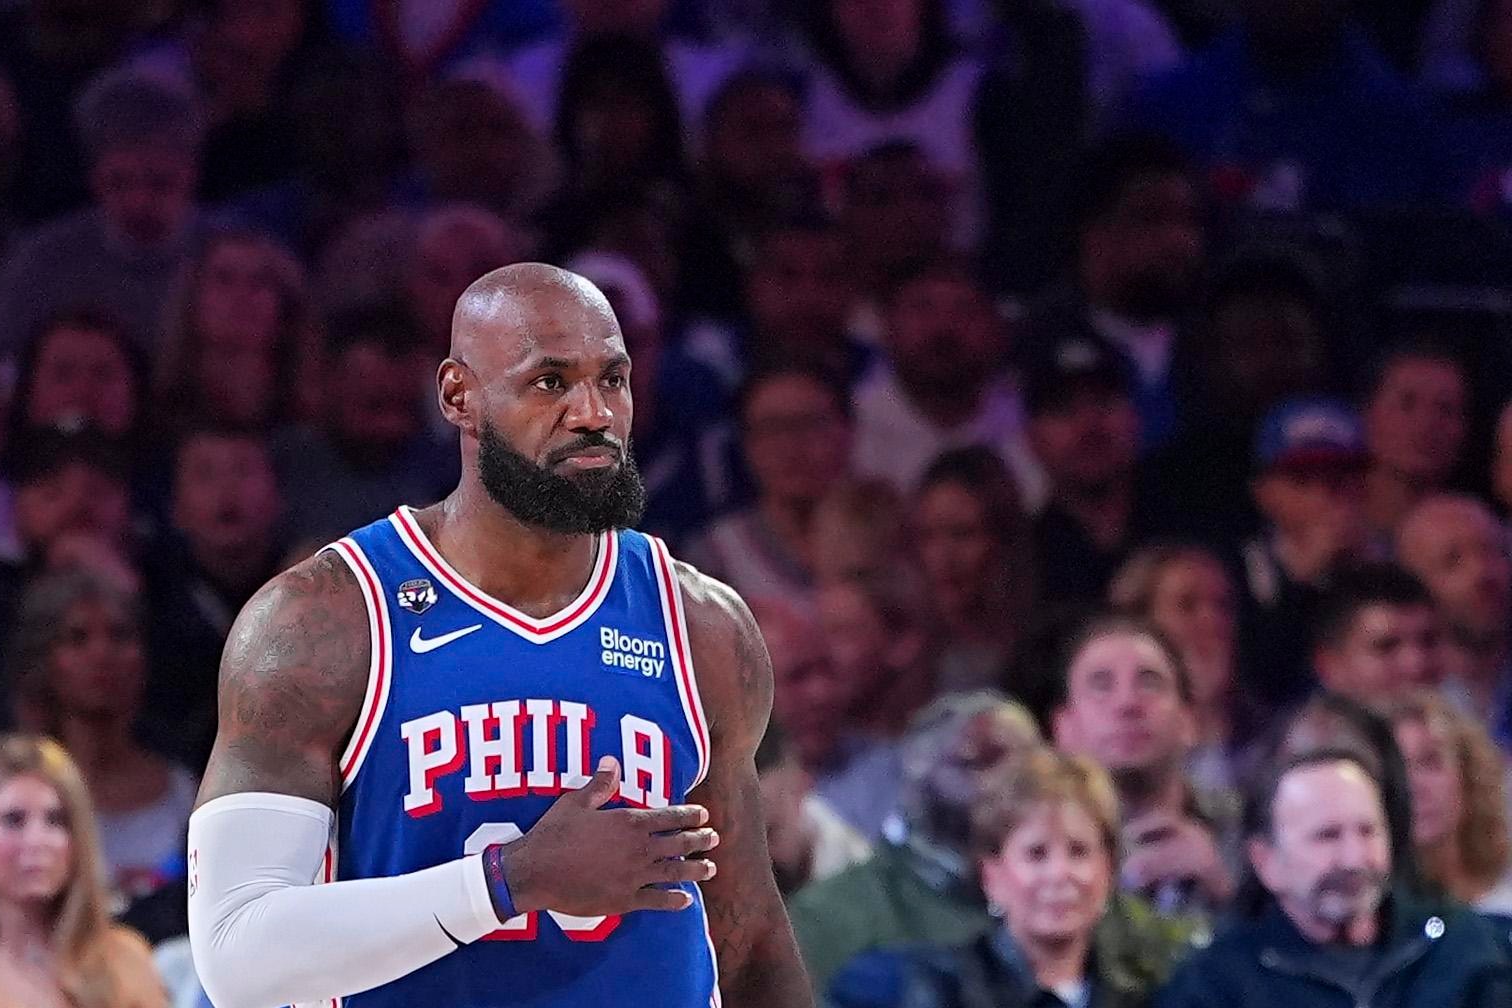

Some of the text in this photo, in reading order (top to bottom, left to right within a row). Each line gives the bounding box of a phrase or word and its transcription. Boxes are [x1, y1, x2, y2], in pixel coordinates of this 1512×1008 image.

[600, 626, 665, 658] Bloom
[601, 650, 665, 678] energy
[401, 699, 671, 817] PHILA
